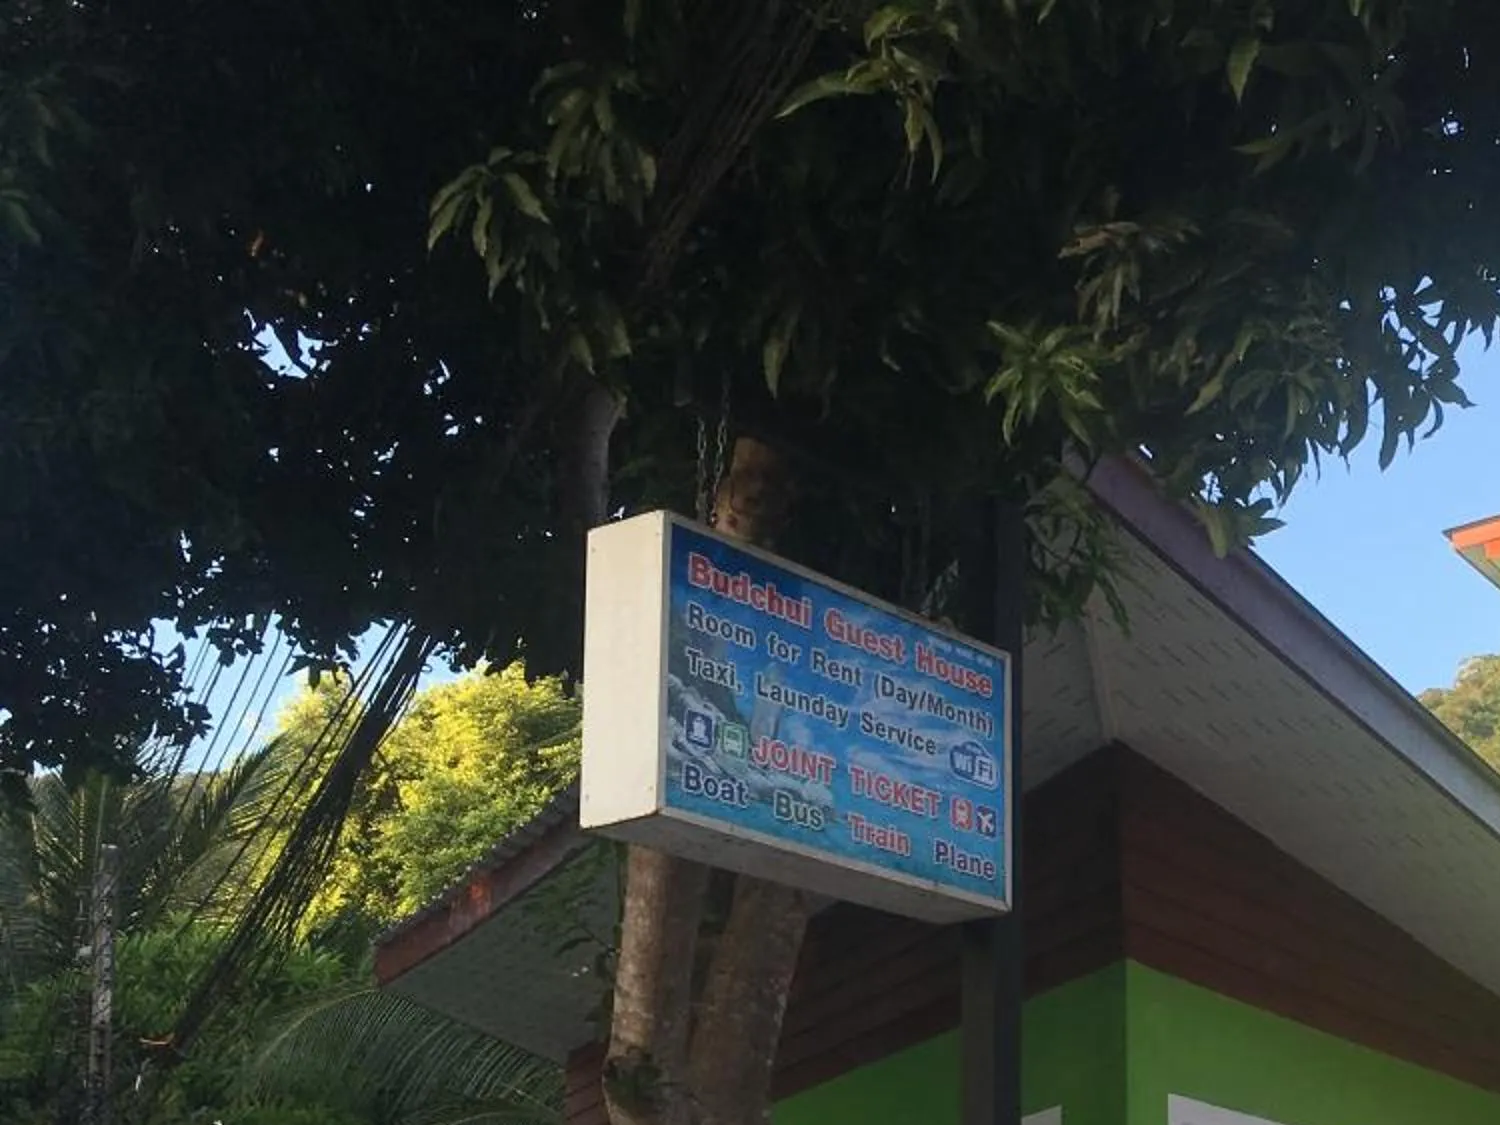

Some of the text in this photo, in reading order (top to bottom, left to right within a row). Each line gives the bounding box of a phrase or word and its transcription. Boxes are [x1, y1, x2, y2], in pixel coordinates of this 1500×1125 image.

[687, 600, 995, 740] Room for Rent (Day/Month)
[688, 551, 813, 630] Budchui
[824, 607, 906, 665] Guest
[915, 639, 993, 698] House
[685, 645, 937, 756] Taxi, Launday Service
[683, 760, 996, 882] Boat Bus Train Plane
[752, 735, 942, 820] JOINT TICKET
